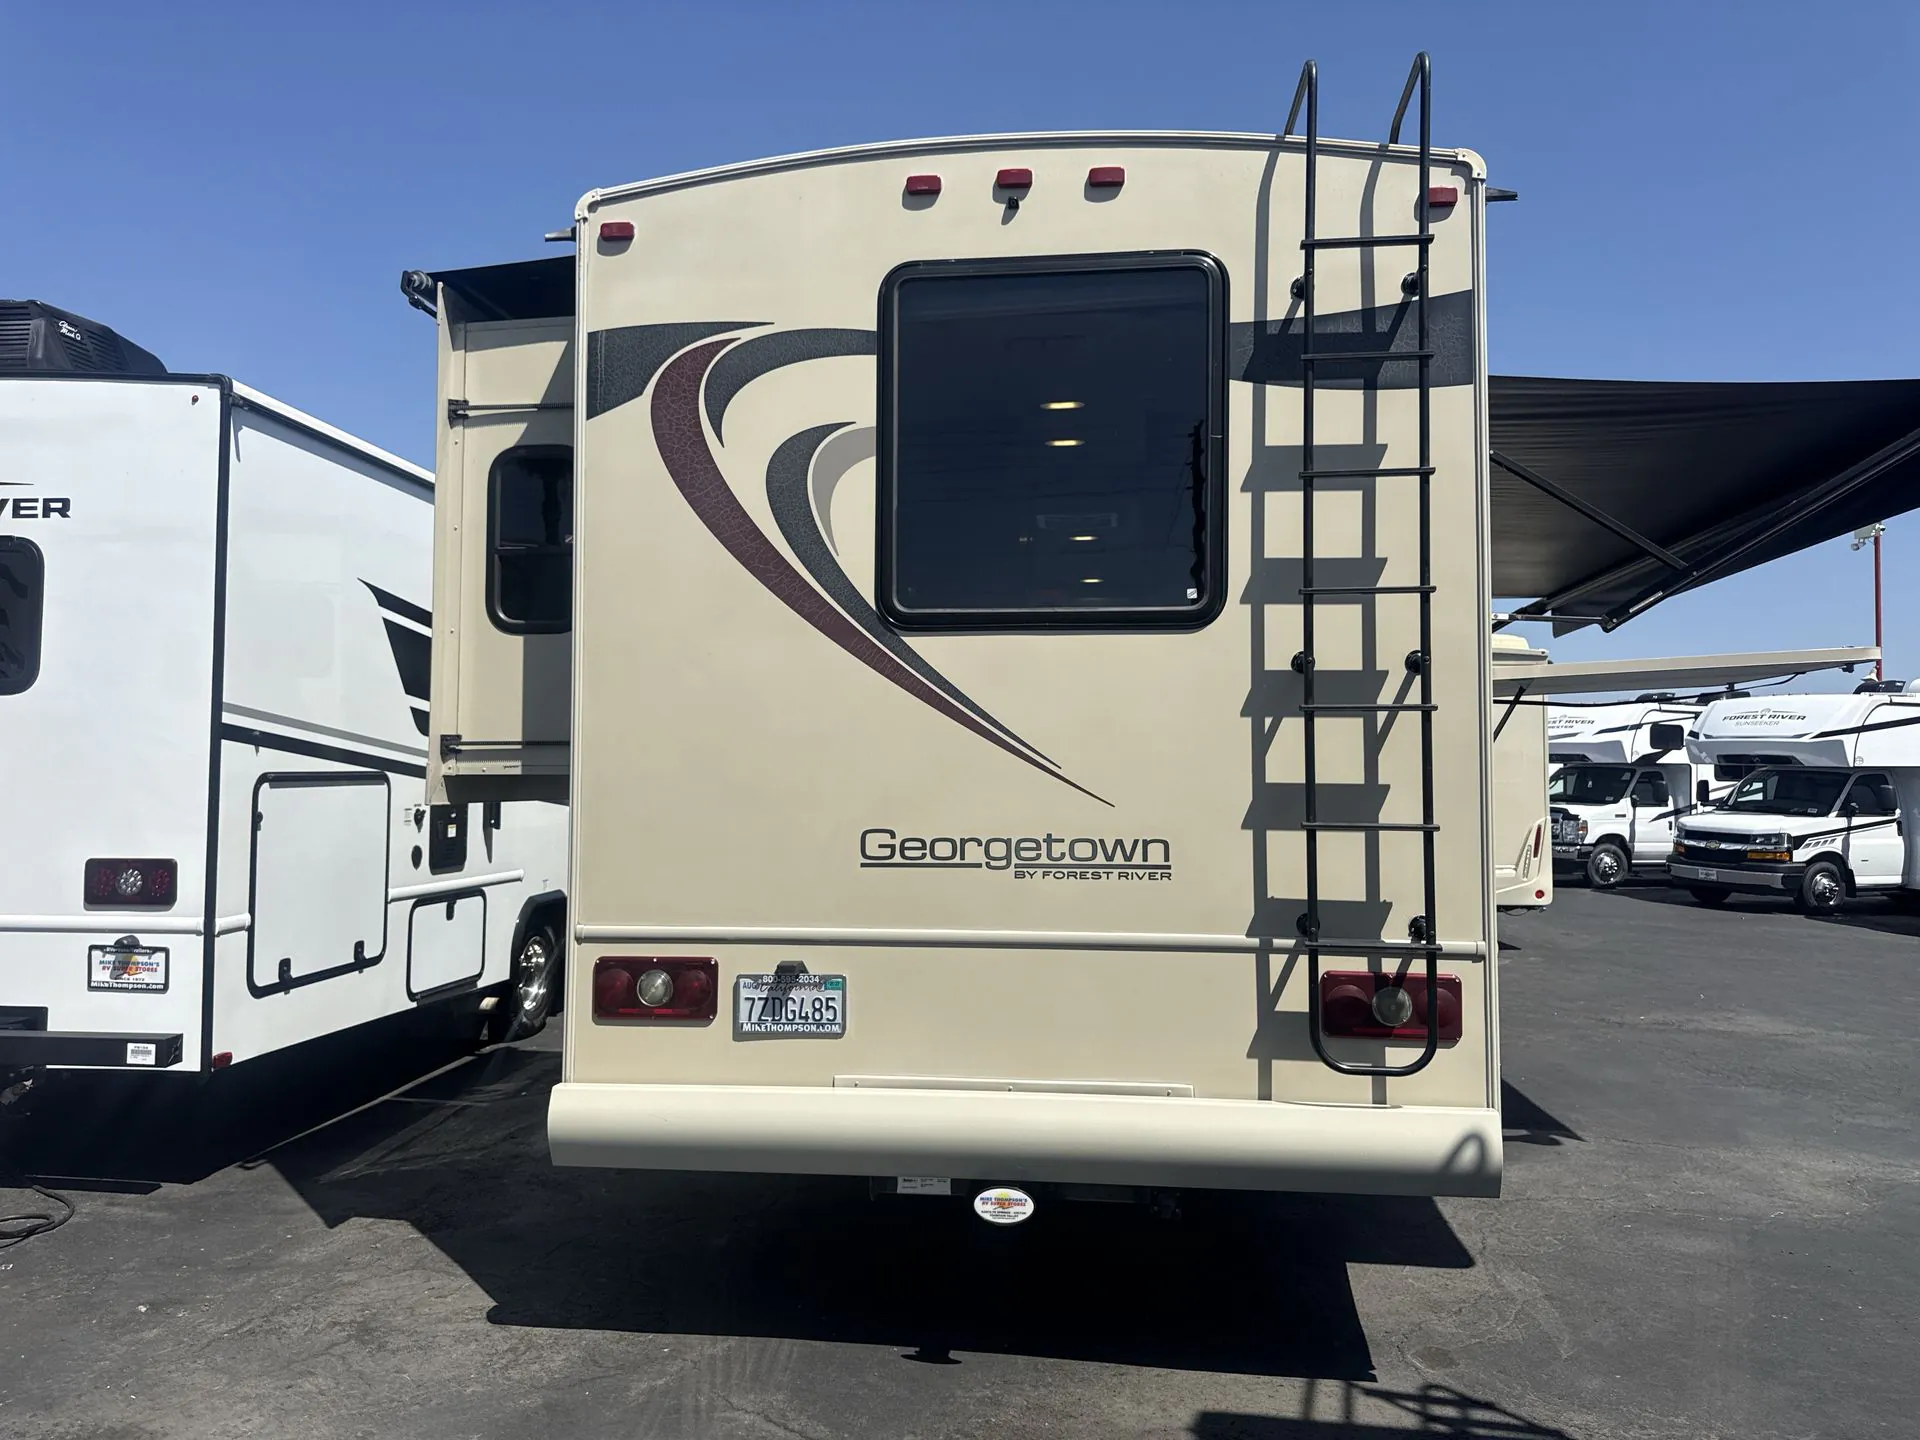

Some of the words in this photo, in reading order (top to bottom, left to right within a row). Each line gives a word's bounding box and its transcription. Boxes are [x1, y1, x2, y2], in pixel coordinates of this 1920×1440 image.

[1722, 714, 1766, 722] FOREST
[860, 828, 1170, 870] Georgetown
[1014, 870, 1038, 880] BY
[1042, 870, 1114, 881] FOREST
[1118, 871, 1172, 881] RIVER
[90, 981, 164, 990] MikeThompson.com
[744, 996, 838, 1022] 7ZDG485
